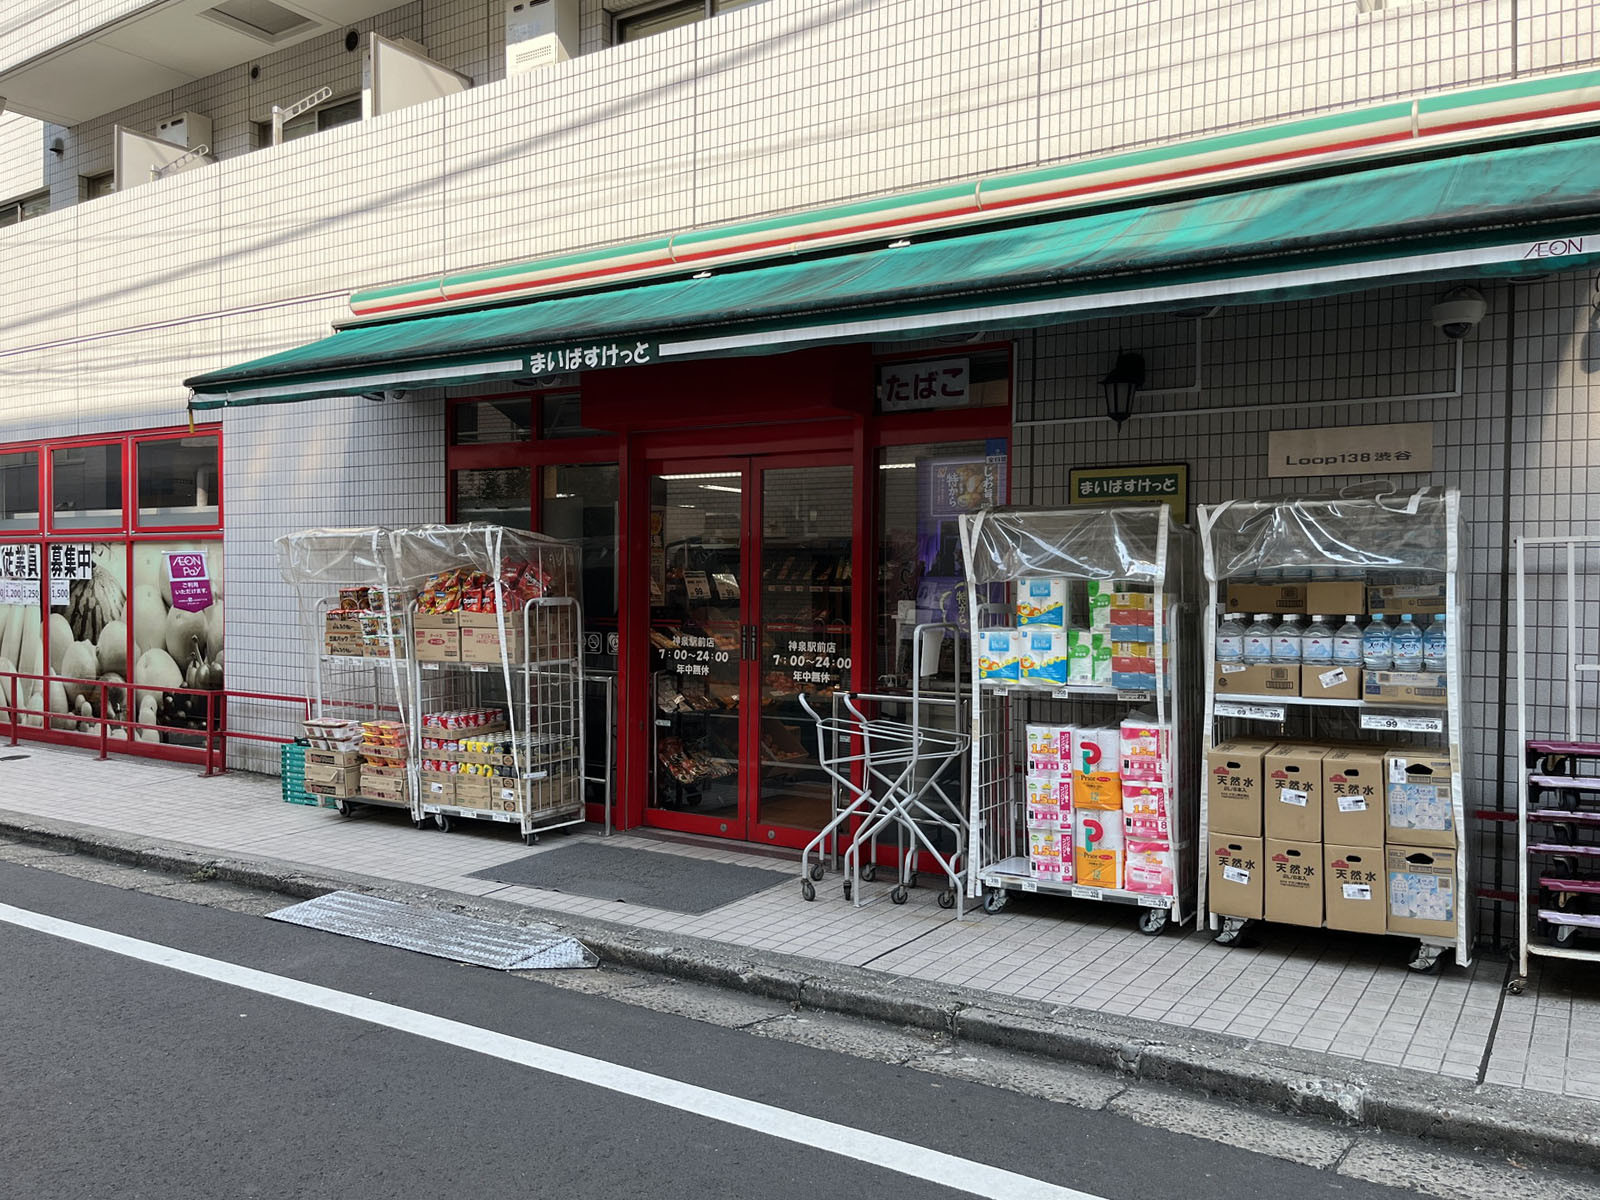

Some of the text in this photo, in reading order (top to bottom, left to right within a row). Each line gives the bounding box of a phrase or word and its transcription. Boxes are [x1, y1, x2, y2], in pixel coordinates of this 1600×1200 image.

[529, 341, 650, 374] まいばすけっと
[886, 367, 965, 402] たばこ
[1286, 450, 1413, 466] Loop138 渋谷
[1080, 478, 1176, 495] まいばすけっと
[51, 544, 91, 578] 募集中
[182, 566, 202, 576] Pay
[51, 589, 68, 598] 1,500
[672, 636, 715, 648] 神泉駅前店
[788, 641, 837, 654] 神泉駅前店
[676, 664, 710, 676] 年中無休
[793, 671, 831, 683] 年中無休
[1385, 720, 1398, 728] 99
[1063, 763, 1069, 771] 8
[1217, 775, 1254, 788] 天然水
[1275, 779, 1314, 792] 天然水
[1333, 783, 1374, 796] 天然水
[1160, 821, 1168, 829] 8
[1218, 856, 1256, 870] 天然水
[1276, 862, 1315, 876] 天然水
[1335, 869, 1377, 881] 天然水
